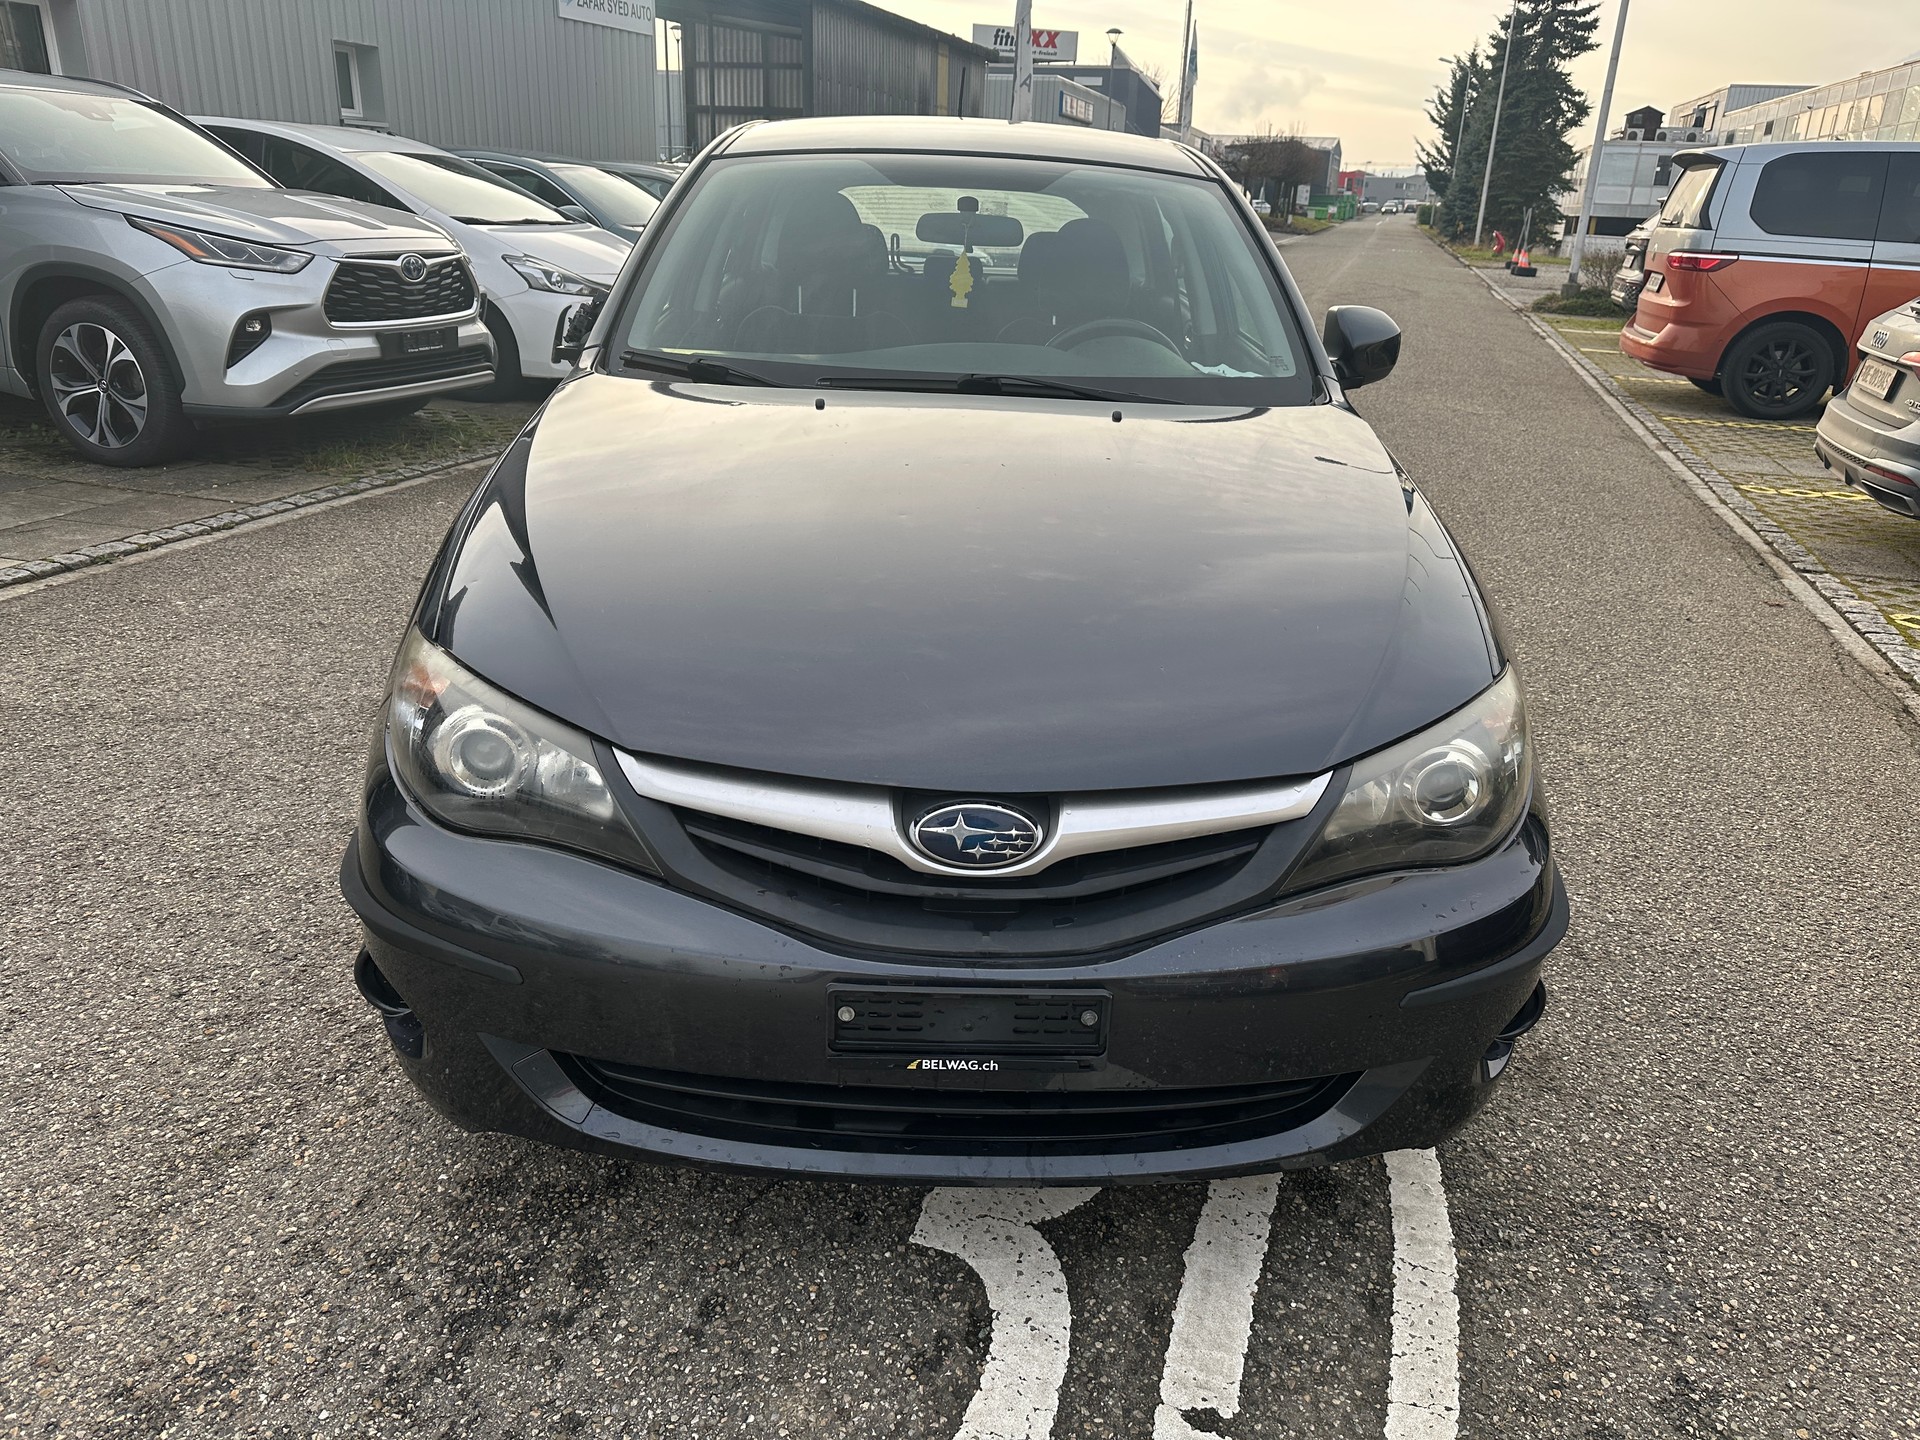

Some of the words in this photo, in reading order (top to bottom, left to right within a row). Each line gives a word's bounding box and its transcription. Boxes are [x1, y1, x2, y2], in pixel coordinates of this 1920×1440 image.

[607, 0, 629, 17] SYED
[630, 3, 652, 22] AUTO
[921, 1059, 999, 1071] BELWAG.ch
